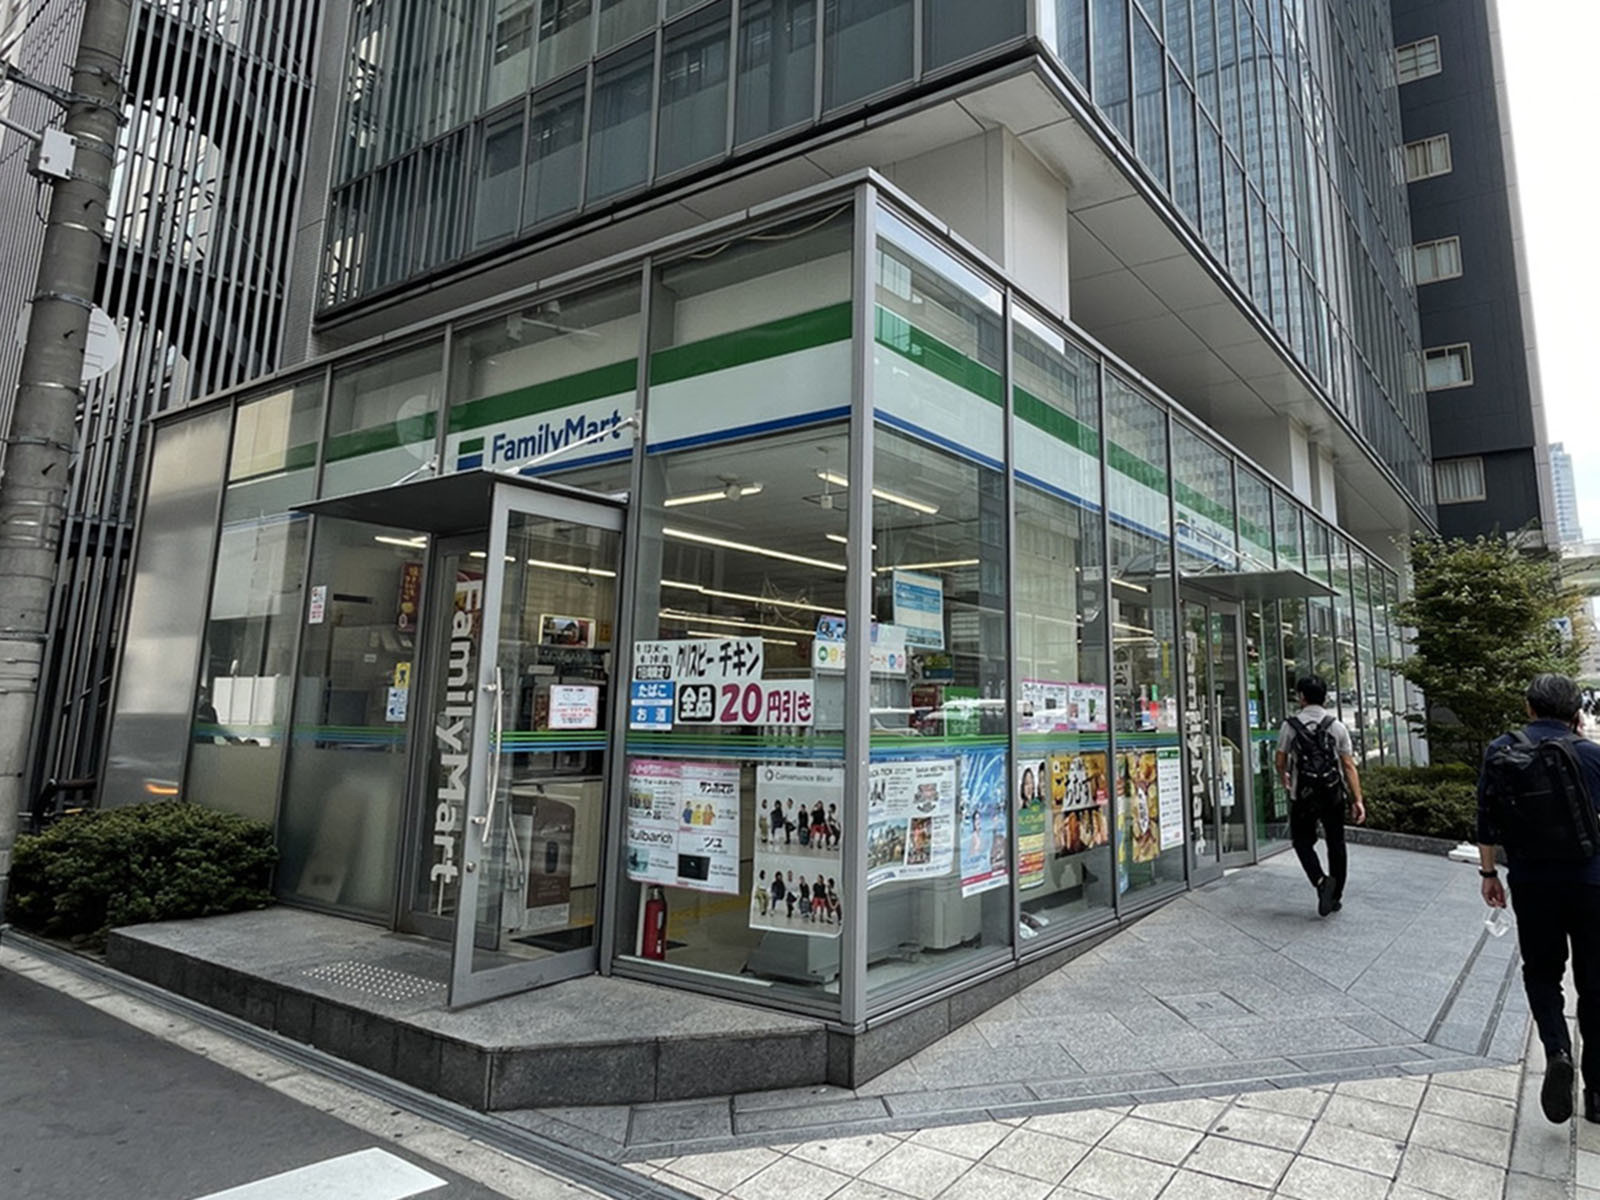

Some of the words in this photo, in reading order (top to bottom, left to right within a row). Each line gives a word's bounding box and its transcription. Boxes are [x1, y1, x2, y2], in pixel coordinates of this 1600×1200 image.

[491, 408, 622, 464] FamilyMart
[676, 641, 760, 678] クリスピーチキン
[637, 683, 668, 698] たばこ
[430, 578, 484, 883] FamilyMart
